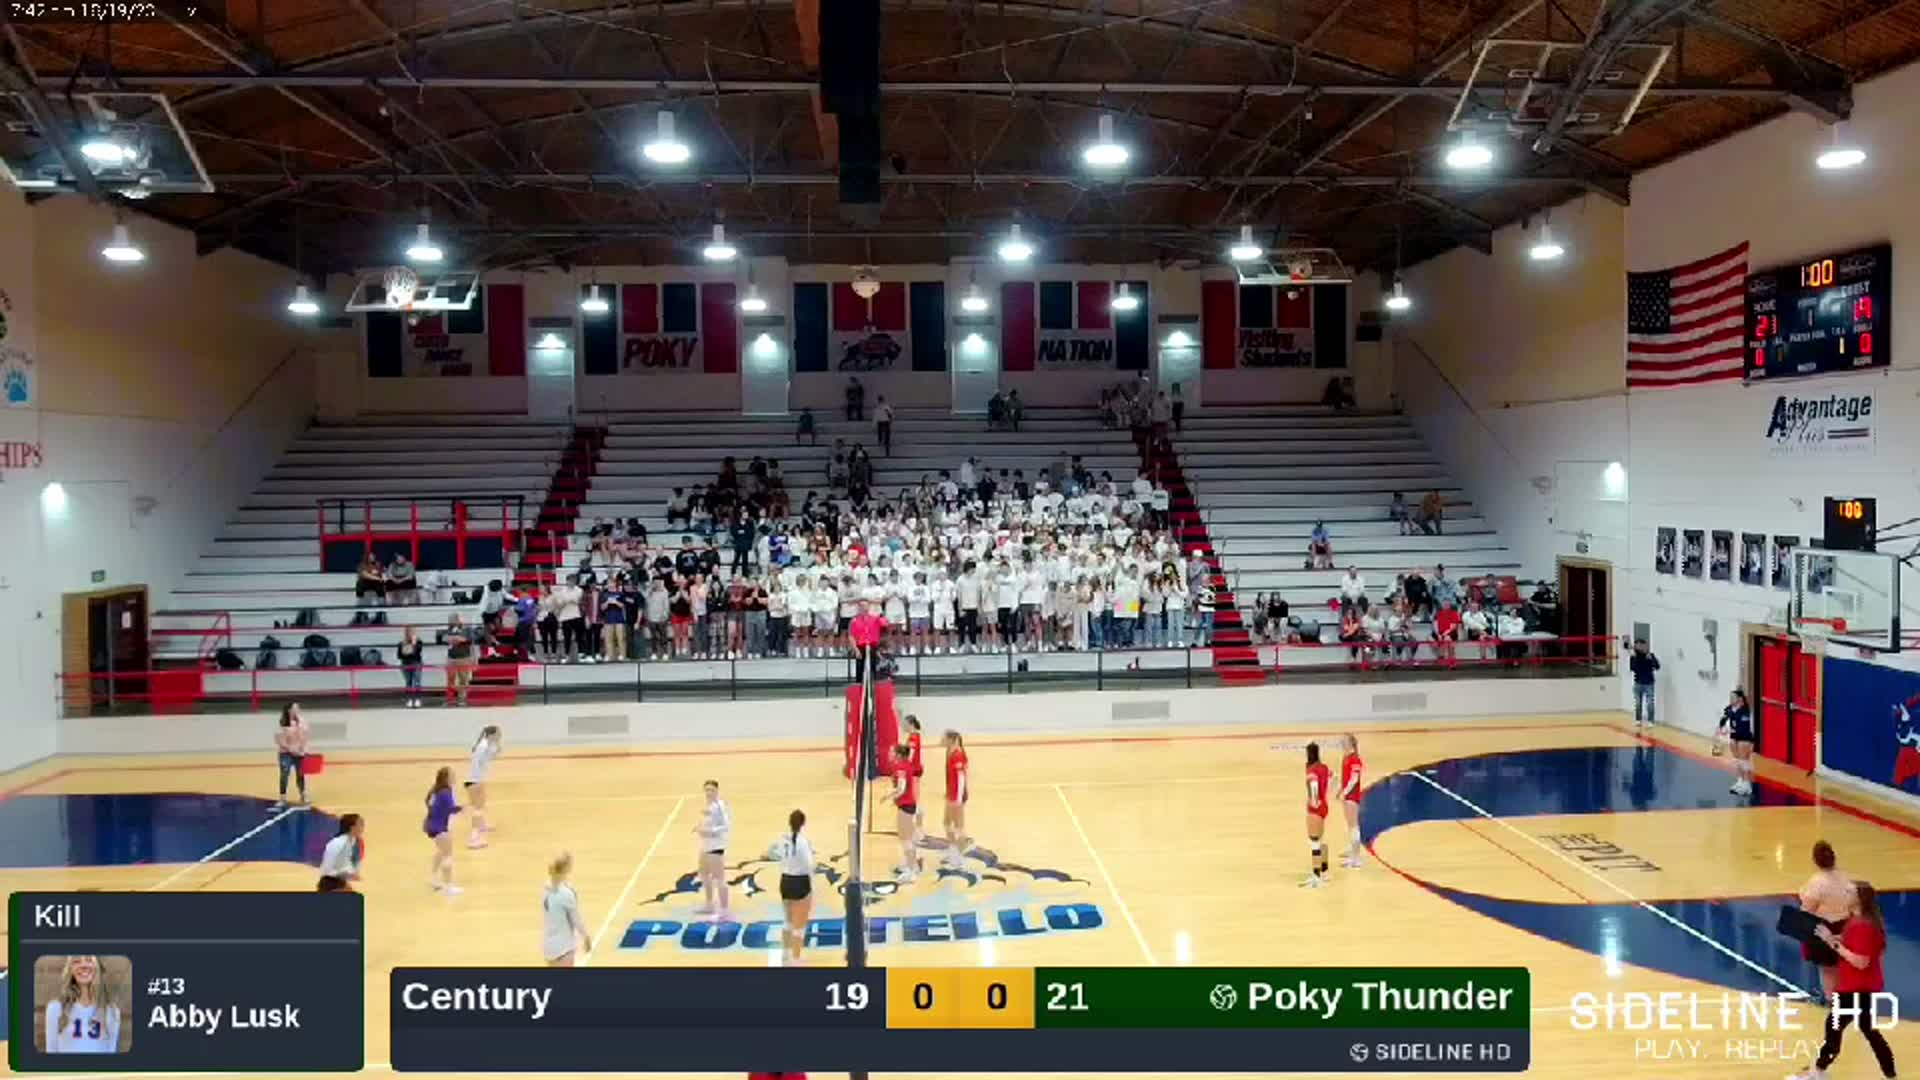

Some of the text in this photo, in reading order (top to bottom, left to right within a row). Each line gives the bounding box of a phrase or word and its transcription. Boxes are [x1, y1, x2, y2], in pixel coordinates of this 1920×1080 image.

[624, 337, 699, 368] POKY
[1039, 338, 1112, 362] NATION
[1767, 395, 1872, 437] Advantage
[617, 902, 1104, 950] POCATELLO
[72, 1018, 102, 1039] 13
